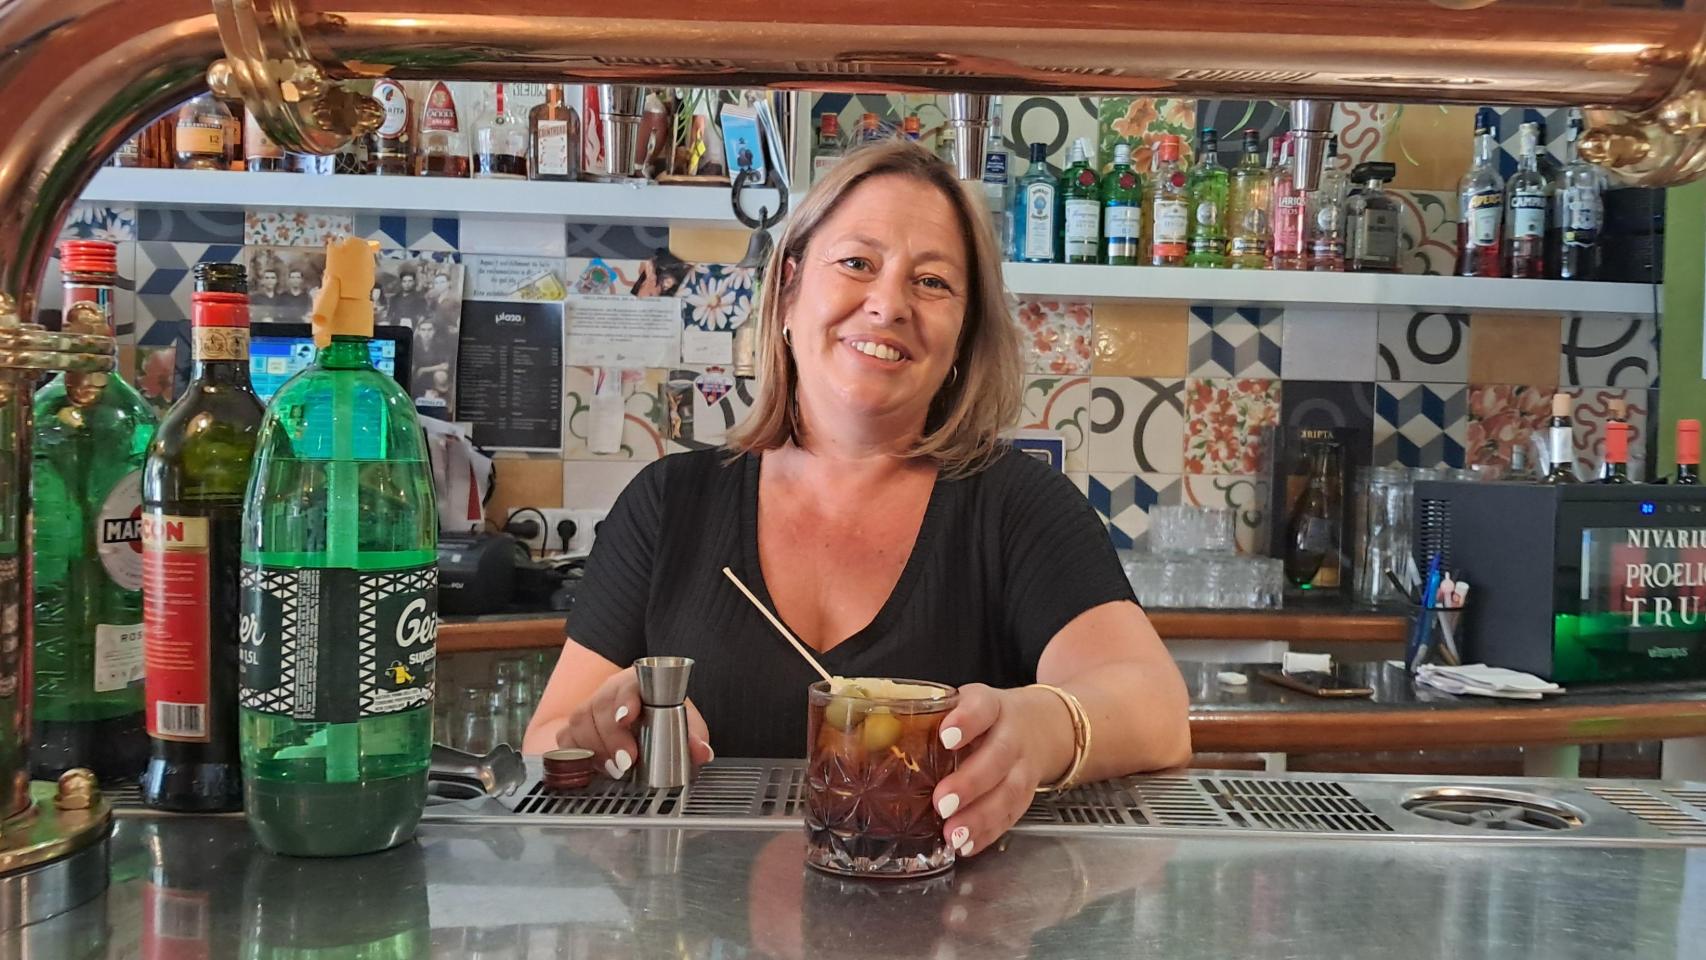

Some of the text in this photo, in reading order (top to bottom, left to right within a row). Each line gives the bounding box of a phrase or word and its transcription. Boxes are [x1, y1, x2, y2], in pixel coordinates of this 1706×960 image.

[1626, 562, 1706, 588] PROELI
[396, 598, 437, 648] Gei
[1625, 595, 1706, 628] TRU
